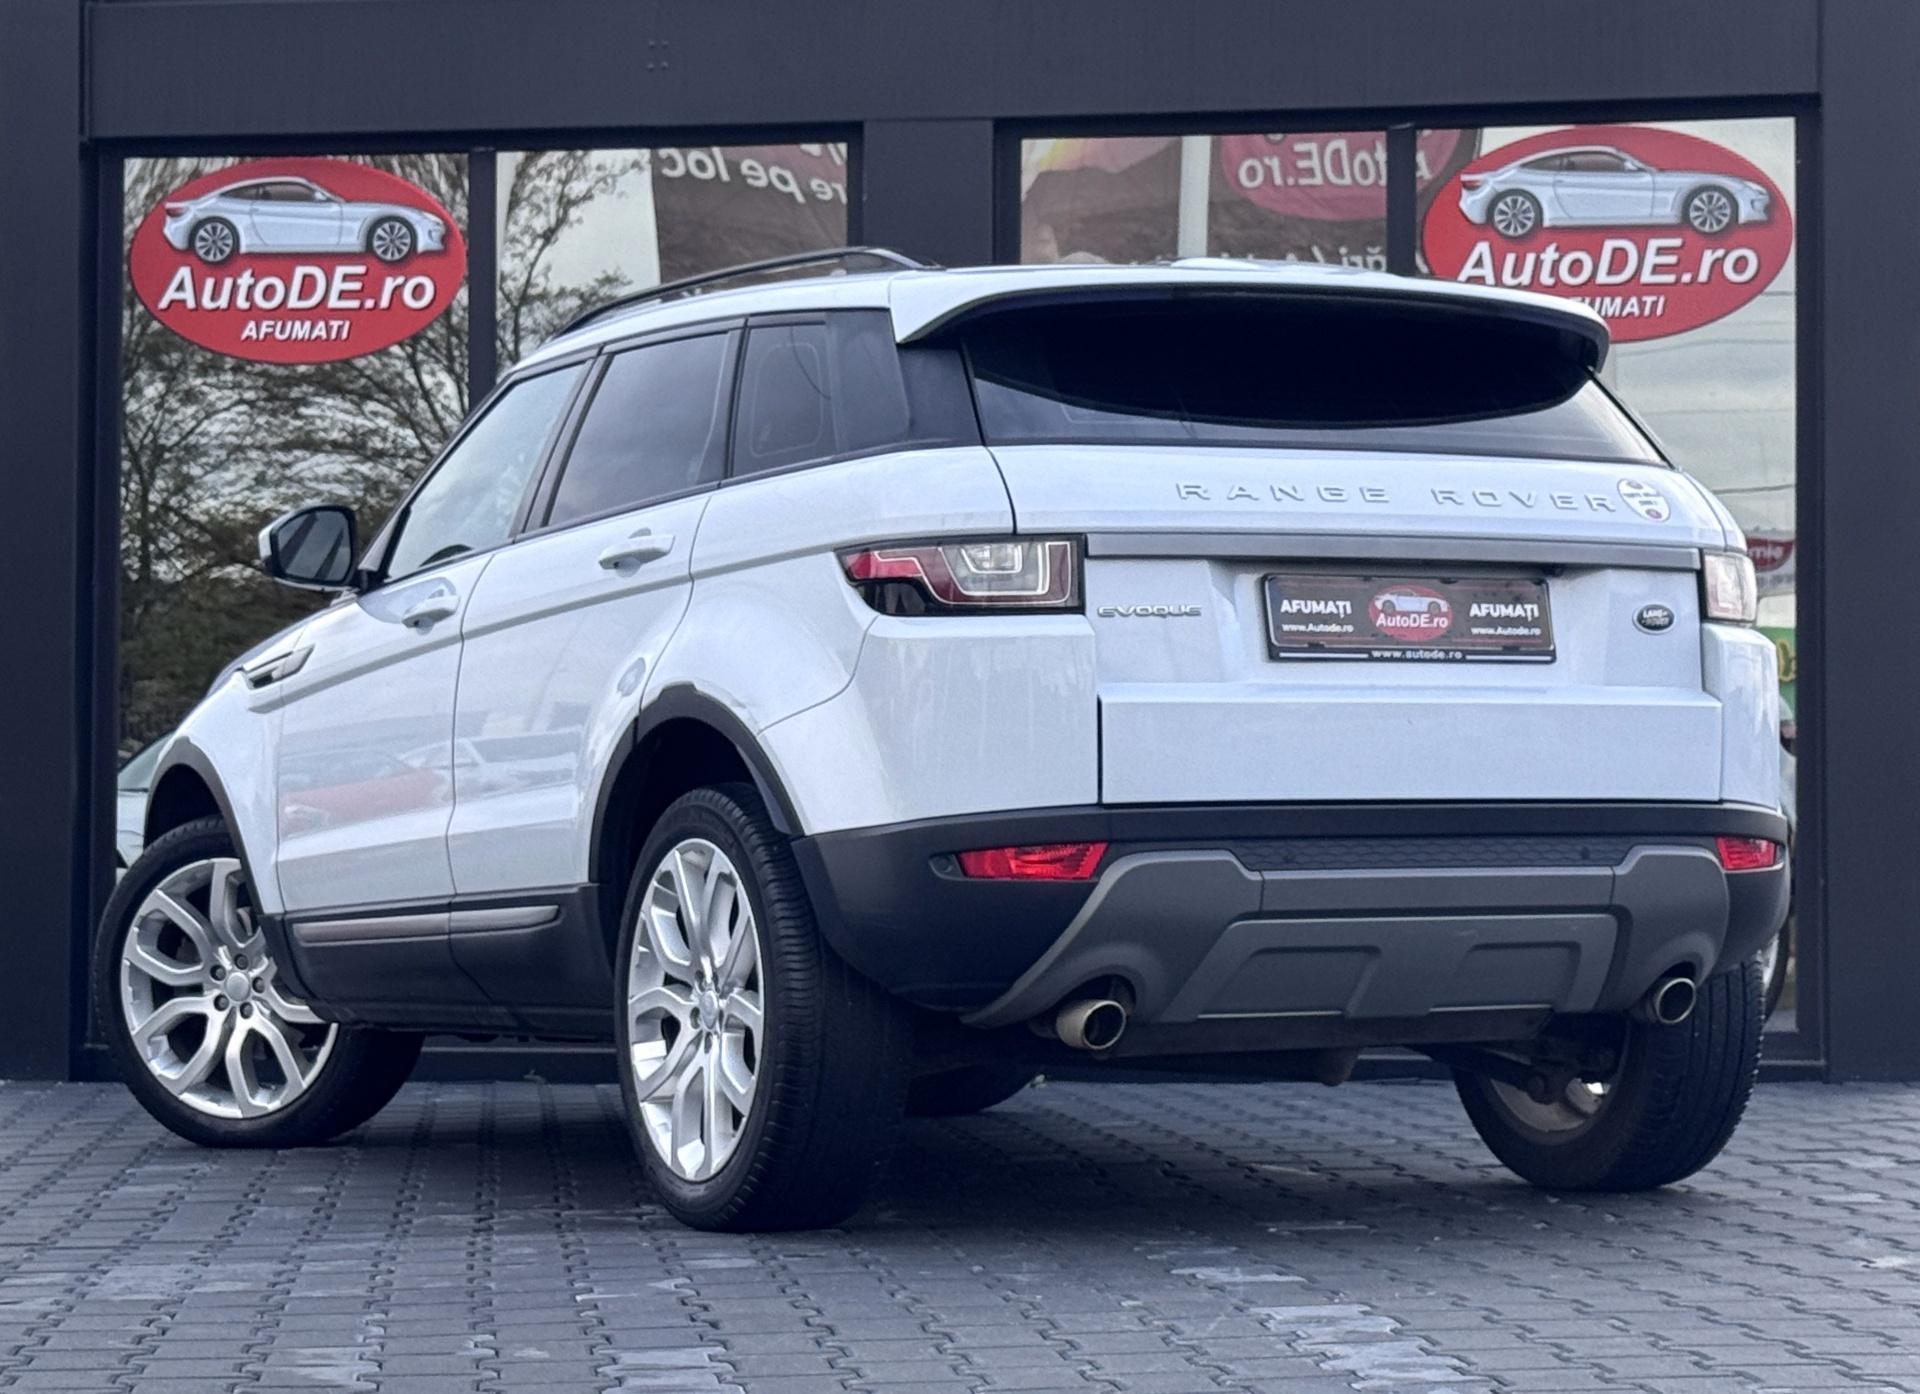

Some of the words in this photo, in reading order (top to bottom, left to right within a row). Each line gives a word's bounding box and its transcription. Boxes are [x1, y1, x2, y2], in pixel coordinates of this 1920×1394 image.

[1457, 237, 1759, 286] AutoDE.ro
[158, 265, 436, 311] AutoDE.ro
[240, 320, 351, 342] AFUMATI
[1176, 482, 1390, 504] RANGE
[1430, 488, 1616, 513] ROVER
[1098, 604, 1202, 619] EVOQUE
[1376, 613, 1449, 628] AutoDE.ro
